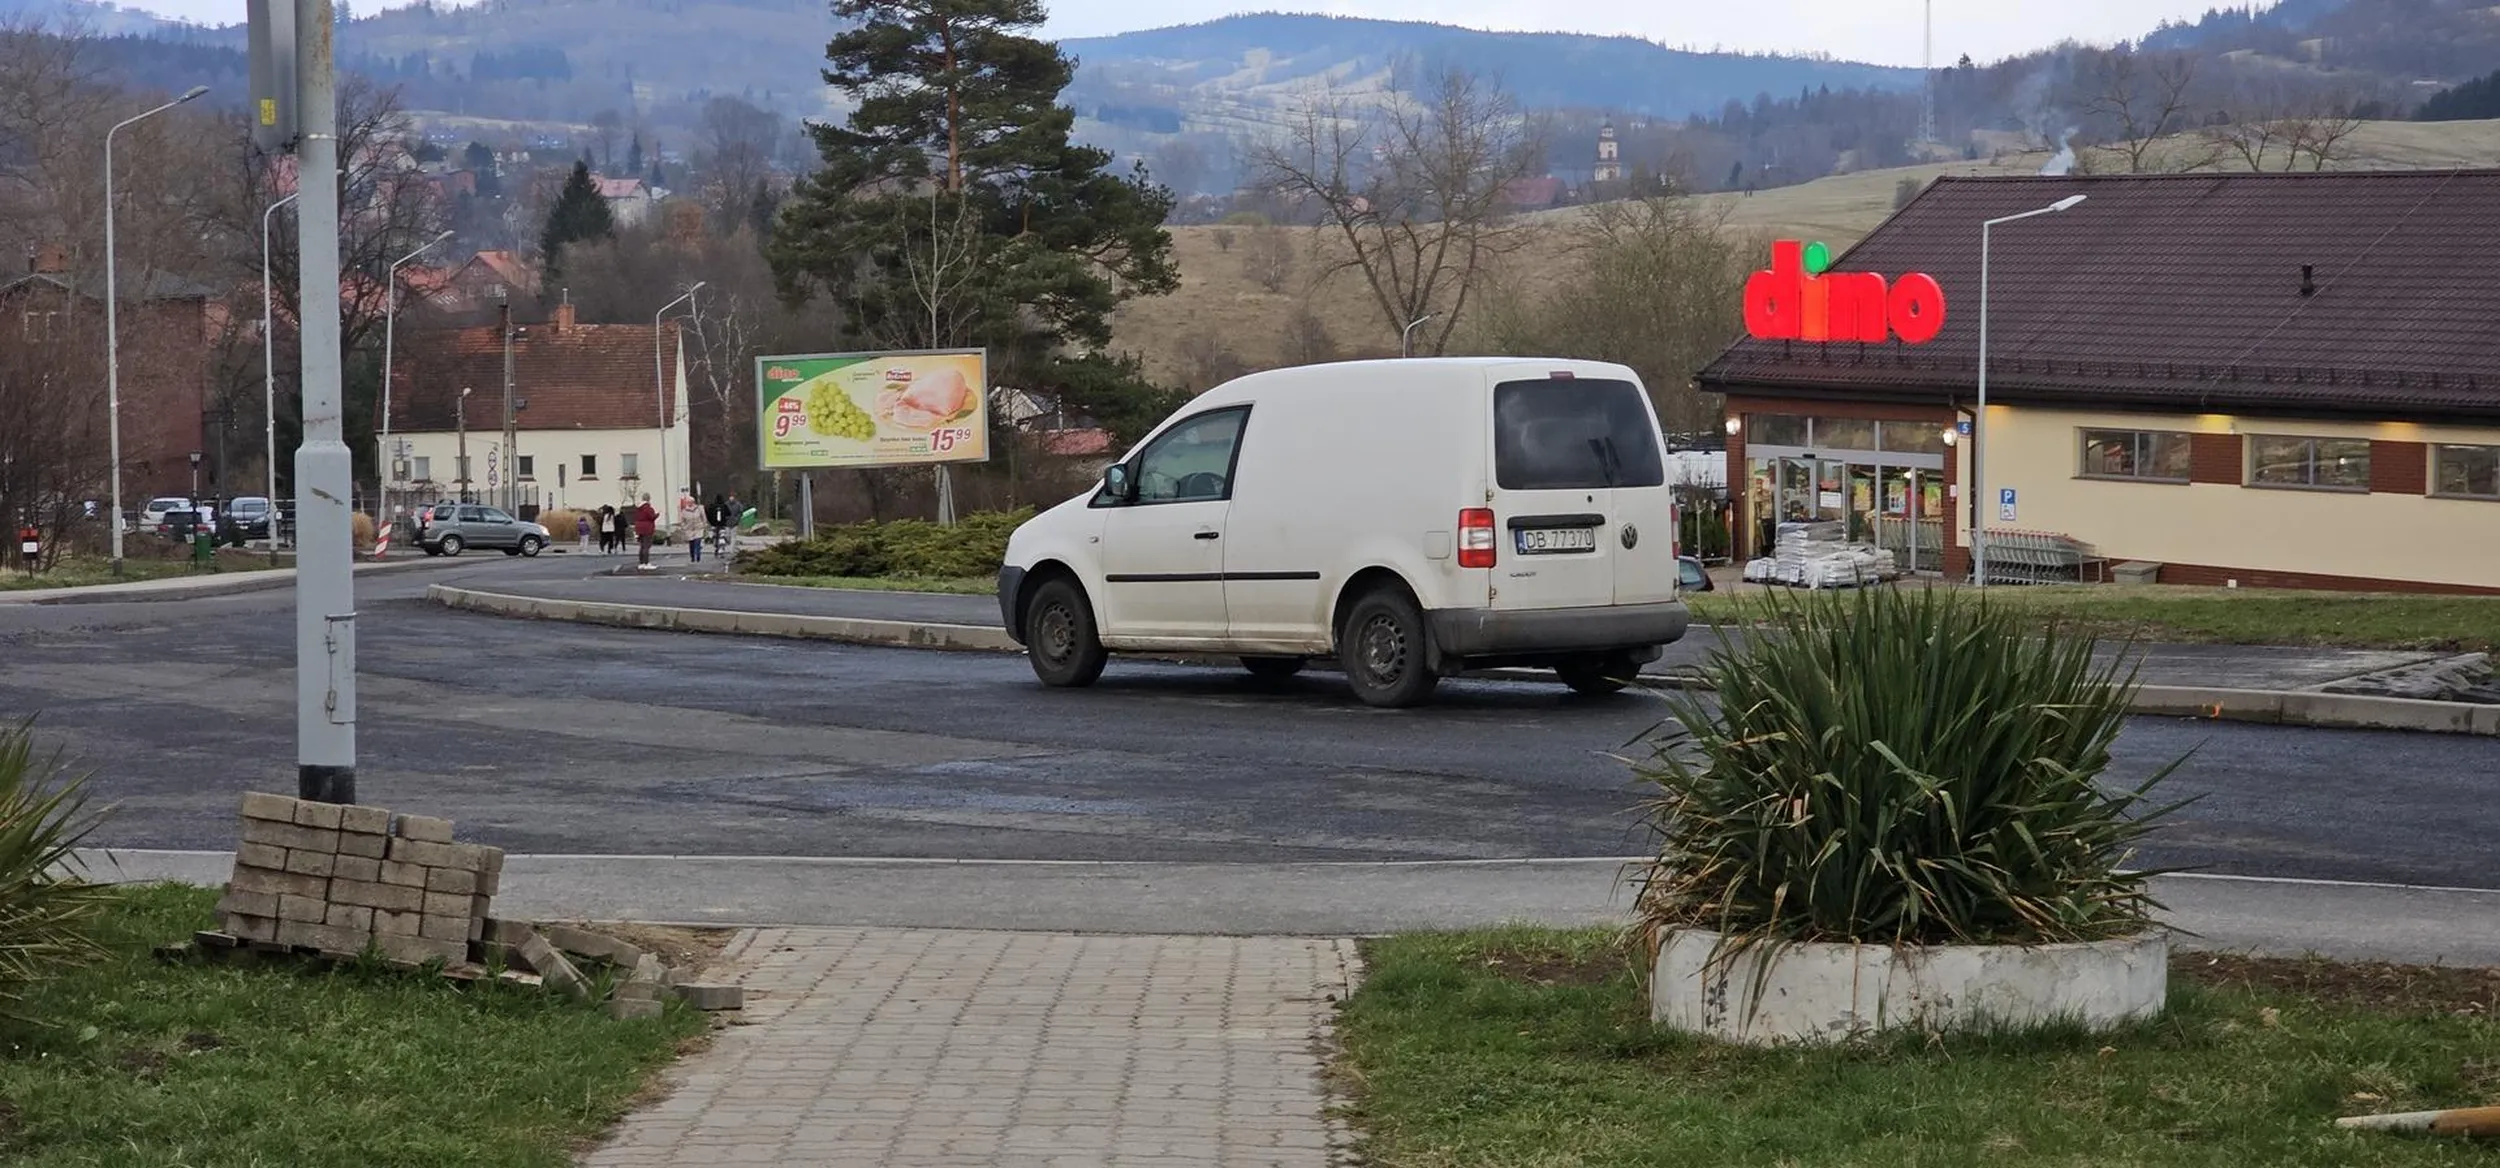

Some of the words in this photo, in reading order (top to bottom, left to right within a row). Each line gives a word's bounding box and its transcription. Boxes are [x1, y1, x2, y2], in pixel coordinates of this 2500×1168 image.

[1744, 239, 1947, 344] dino
[767, 366, 800, 379] dino
[2004, 490, 2012, 502] P
[1526, 531, 1546, 549] DB
[1552, 530, 1592, 547] 77370
